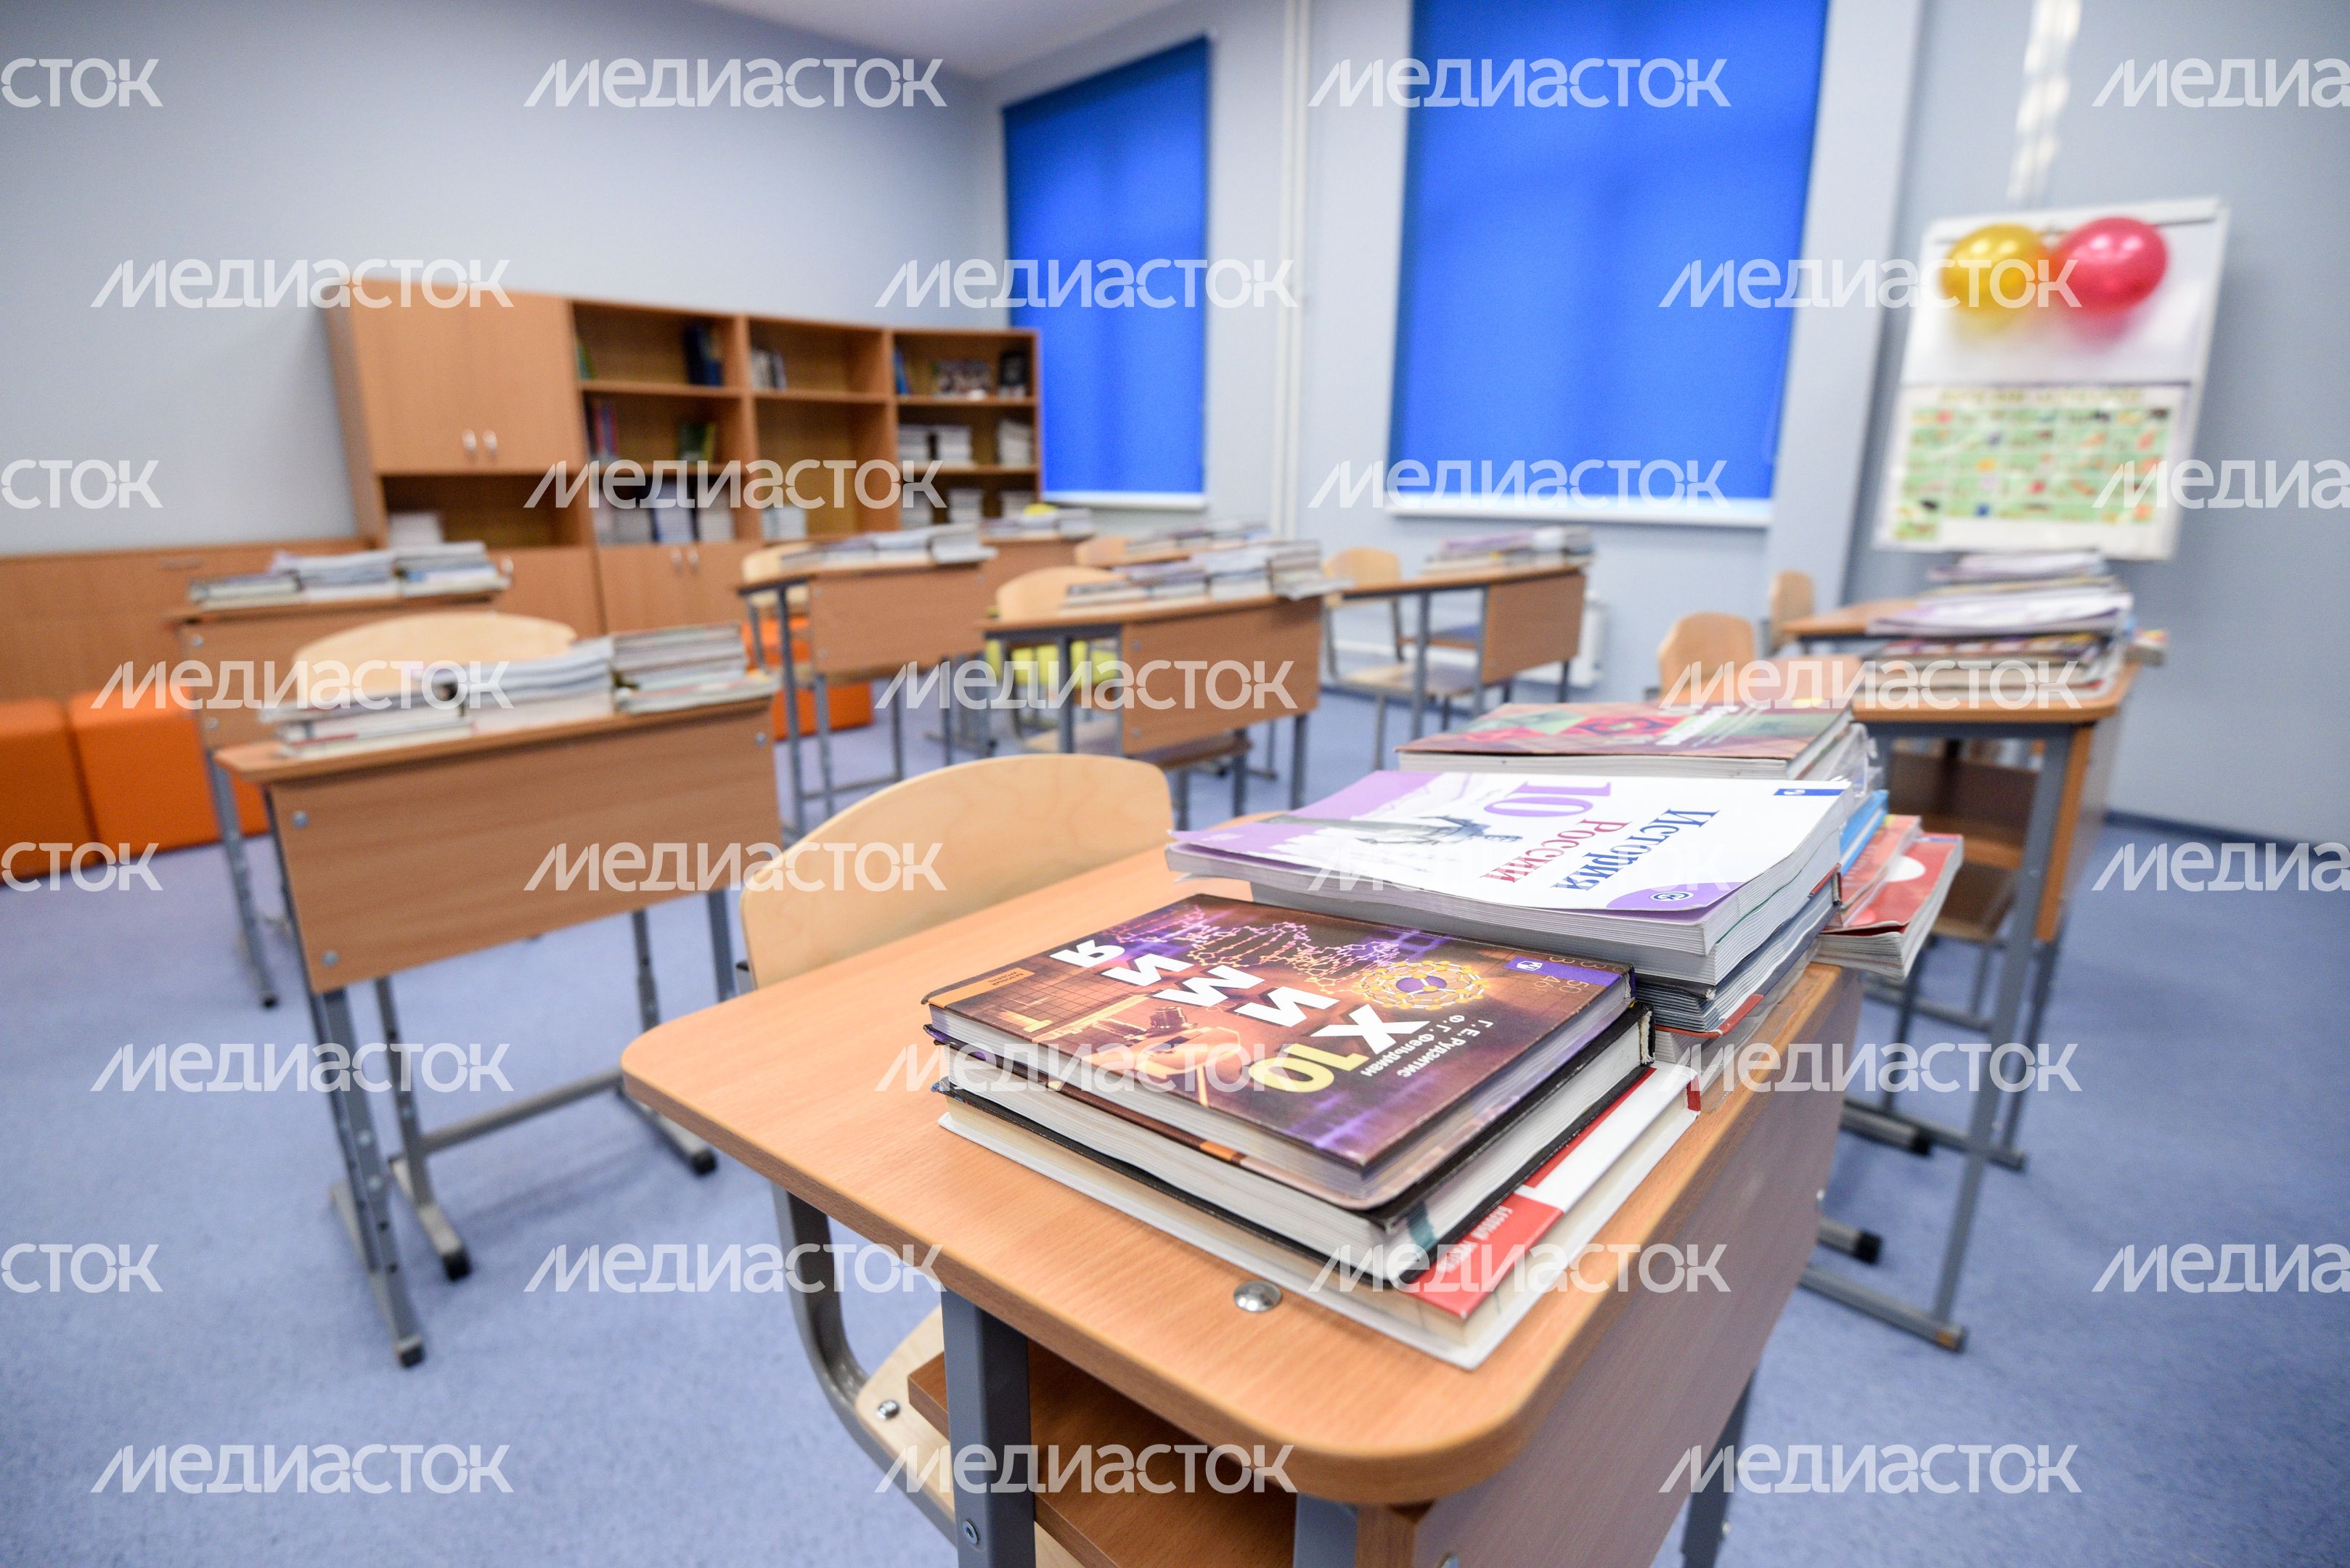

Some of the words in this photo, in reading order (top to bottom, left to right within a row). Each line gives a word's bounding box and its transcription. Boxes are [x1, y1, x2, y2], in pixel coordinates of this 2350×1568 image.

[1484, 780, 1612, 817] 10
[1480, 819, 1632, 883] России
[1550, 808, 1720, 891] История
[1248, 1043, 1369, 1093] 10
[1360, 1032, 1435, 1077] Фельдман
[1397, 1037, 1466, 1077] Рудзитис
